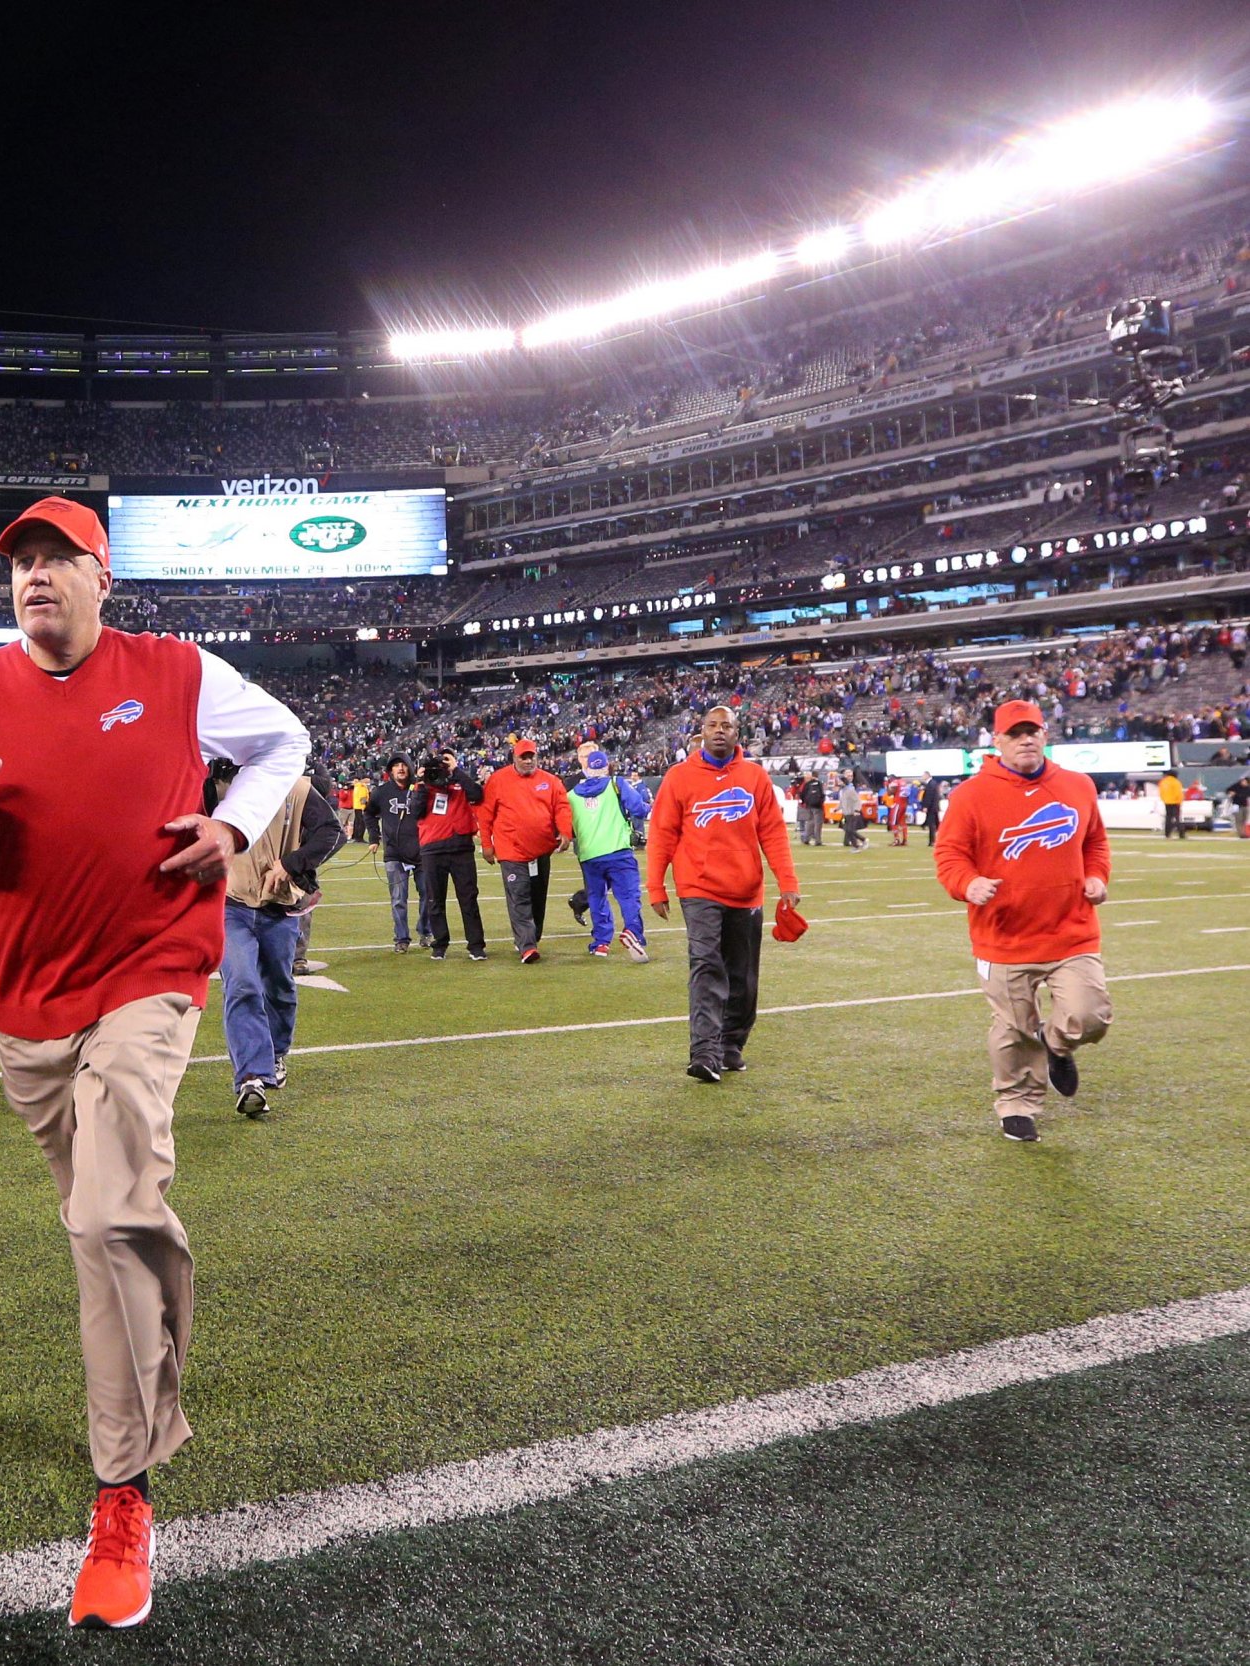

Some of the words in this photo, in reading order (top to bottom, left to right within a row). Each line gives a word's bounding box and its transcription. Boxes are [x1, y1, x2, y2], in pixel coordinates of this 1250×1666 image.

[7, 475, 24, 483] OF
[27, 476, 53, 484] THE
[53, 477, 86, 485] JETS
[221, 474, 318, 496] verizon
[175, 498, 230, 509] NEXT
[237, 497, 299, 507] HOME
[309, 495, 376, 507] GAME
[863, 565, 901, 583] CBS
[912, 562, 924, 576] 2
[936, 550, 998, 573] NEWS
[1094, 517, 1207, 549] 11:00PM
[225, 565, 301, 575] NOVEMBER
[492, 616, 520, 631] CBS
[543, 610, 585, 625] NEWS
[646, 592, 716, 612] 11:00PM
